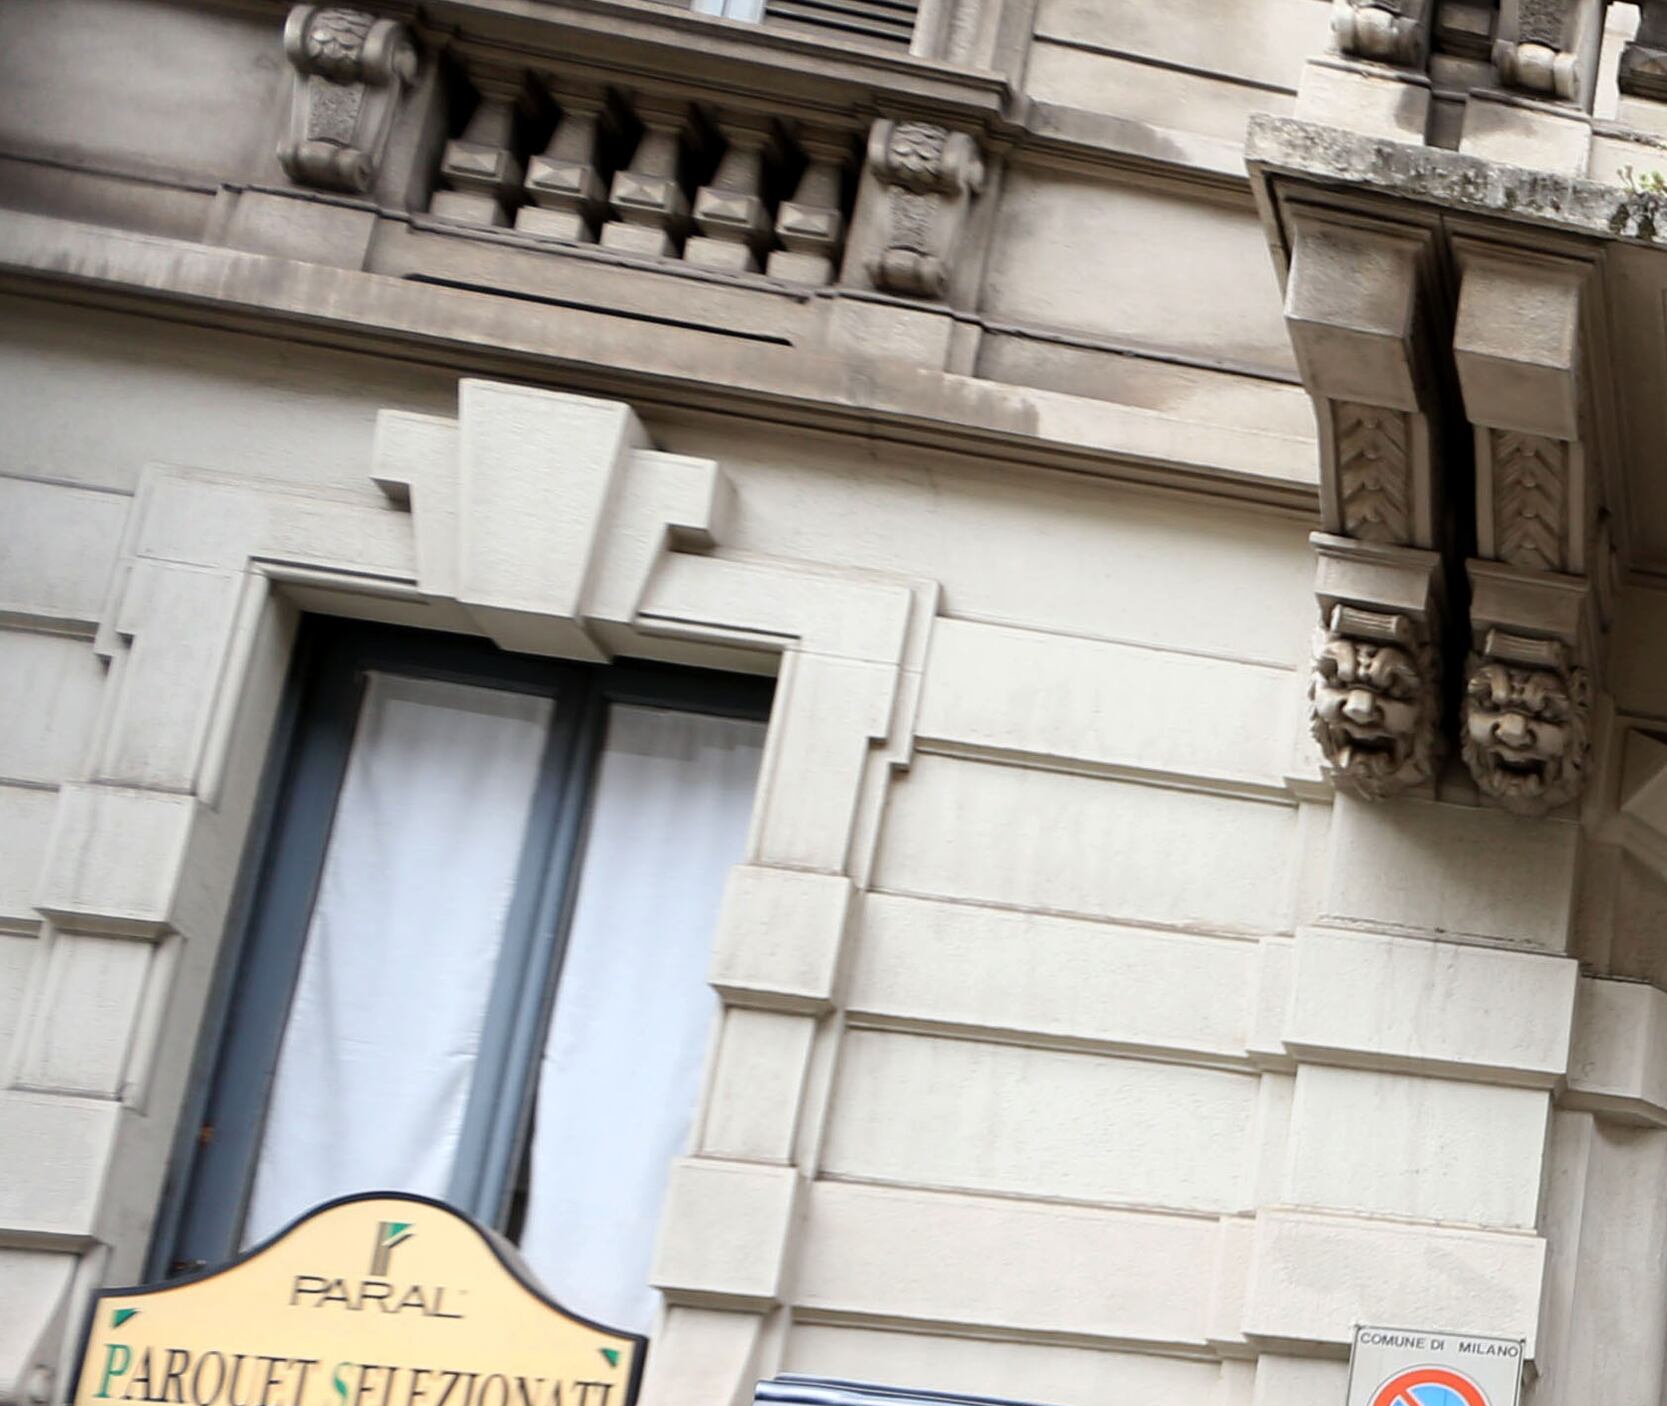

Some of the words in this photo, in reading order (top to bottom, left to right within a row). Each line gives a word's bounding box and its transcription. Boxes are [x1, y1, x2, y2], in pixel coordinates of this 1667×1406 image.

[289, 1275, 465, 1319] PARAL
[1360, 1332, 1425, 1350] COMUNE
[1430, 1338, 1445, 1351] DI
[1458, 1341, 1519, 1358] MILANO
